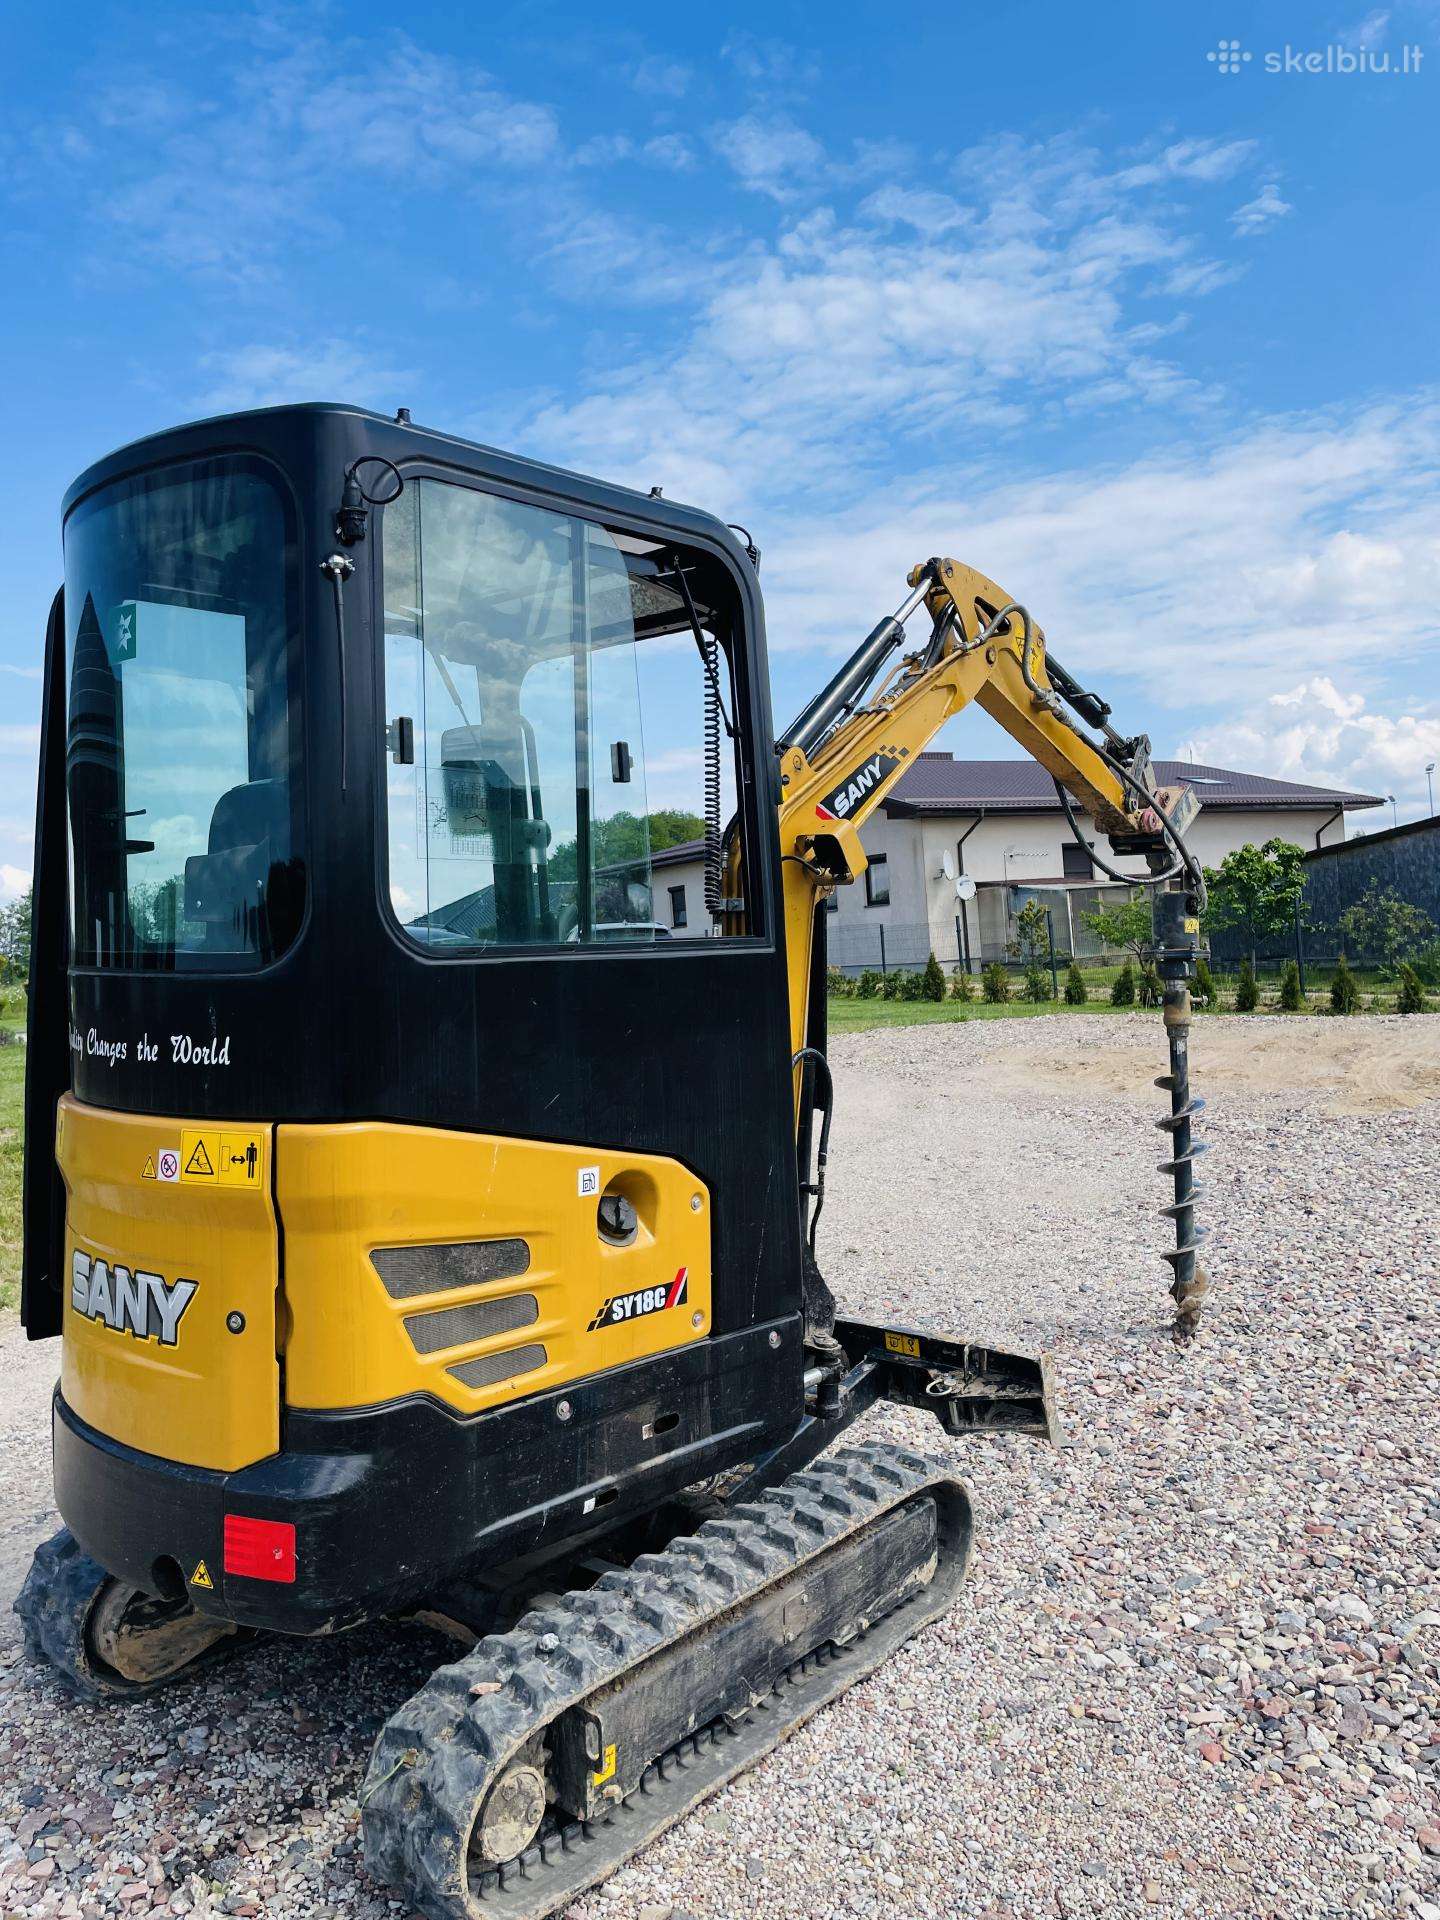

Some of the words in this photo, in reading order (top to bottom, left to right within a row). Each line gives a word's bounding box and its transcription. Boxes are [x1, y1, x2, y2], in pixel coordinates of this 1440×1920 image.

[834, 756, 881, 817] SANY
[87, 1028, 127, 1067] Changes
[137, 1033, 159, 1061] the
[171, 1035, 230, 1065] World
[73, 1249, 198, 1345] SANY
[612, 1286, 666, 1321] SY18C
